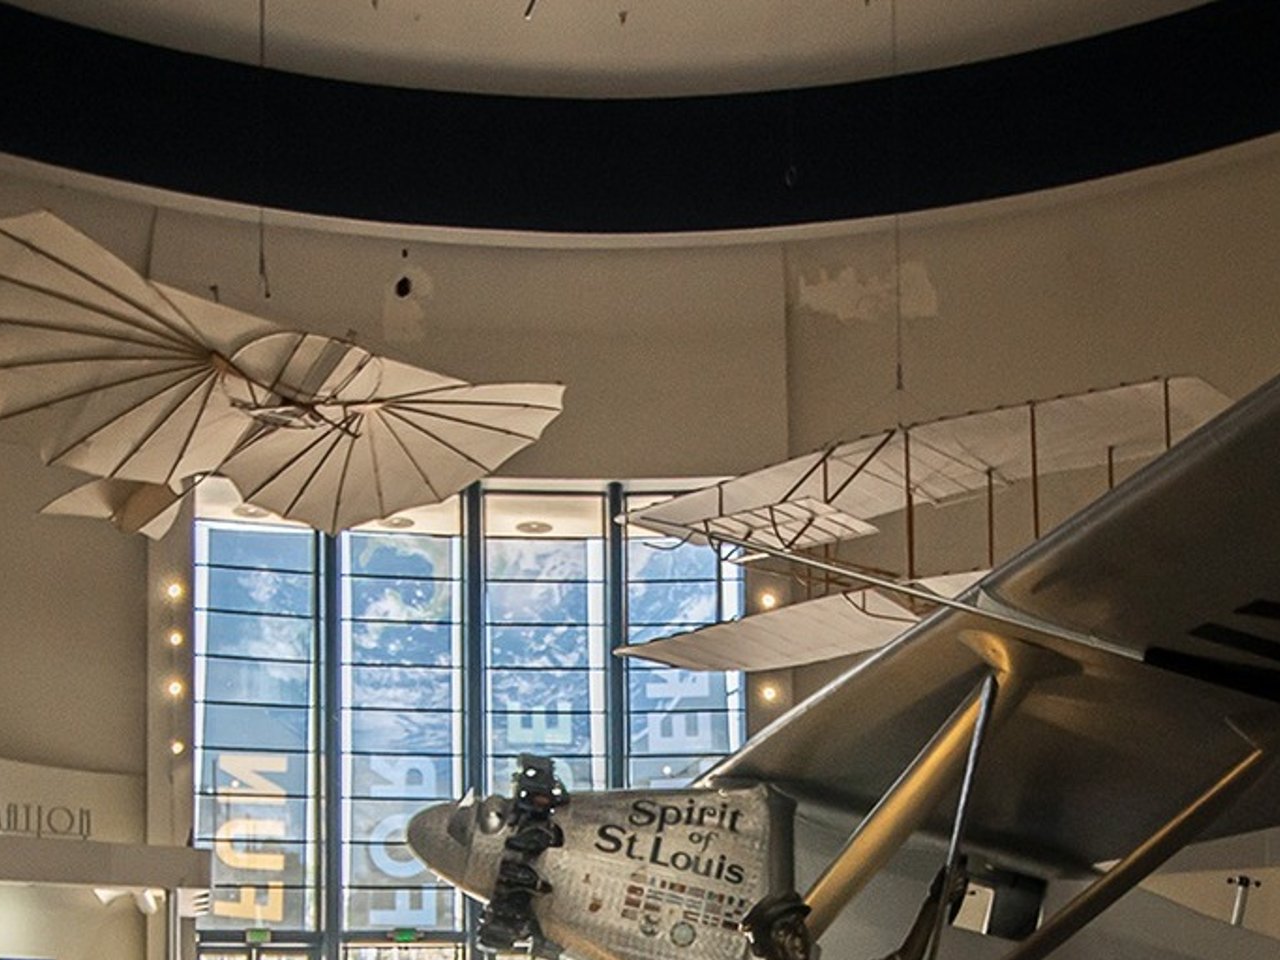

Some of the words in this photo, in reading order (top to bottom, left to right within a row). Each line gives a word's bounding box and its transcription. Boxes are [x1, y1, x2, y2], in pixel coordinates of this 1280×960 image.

[628, 798, 744, 834] Spirit
[688, 831, 719, 852] of
[649, 836, 745, 885] Louis
